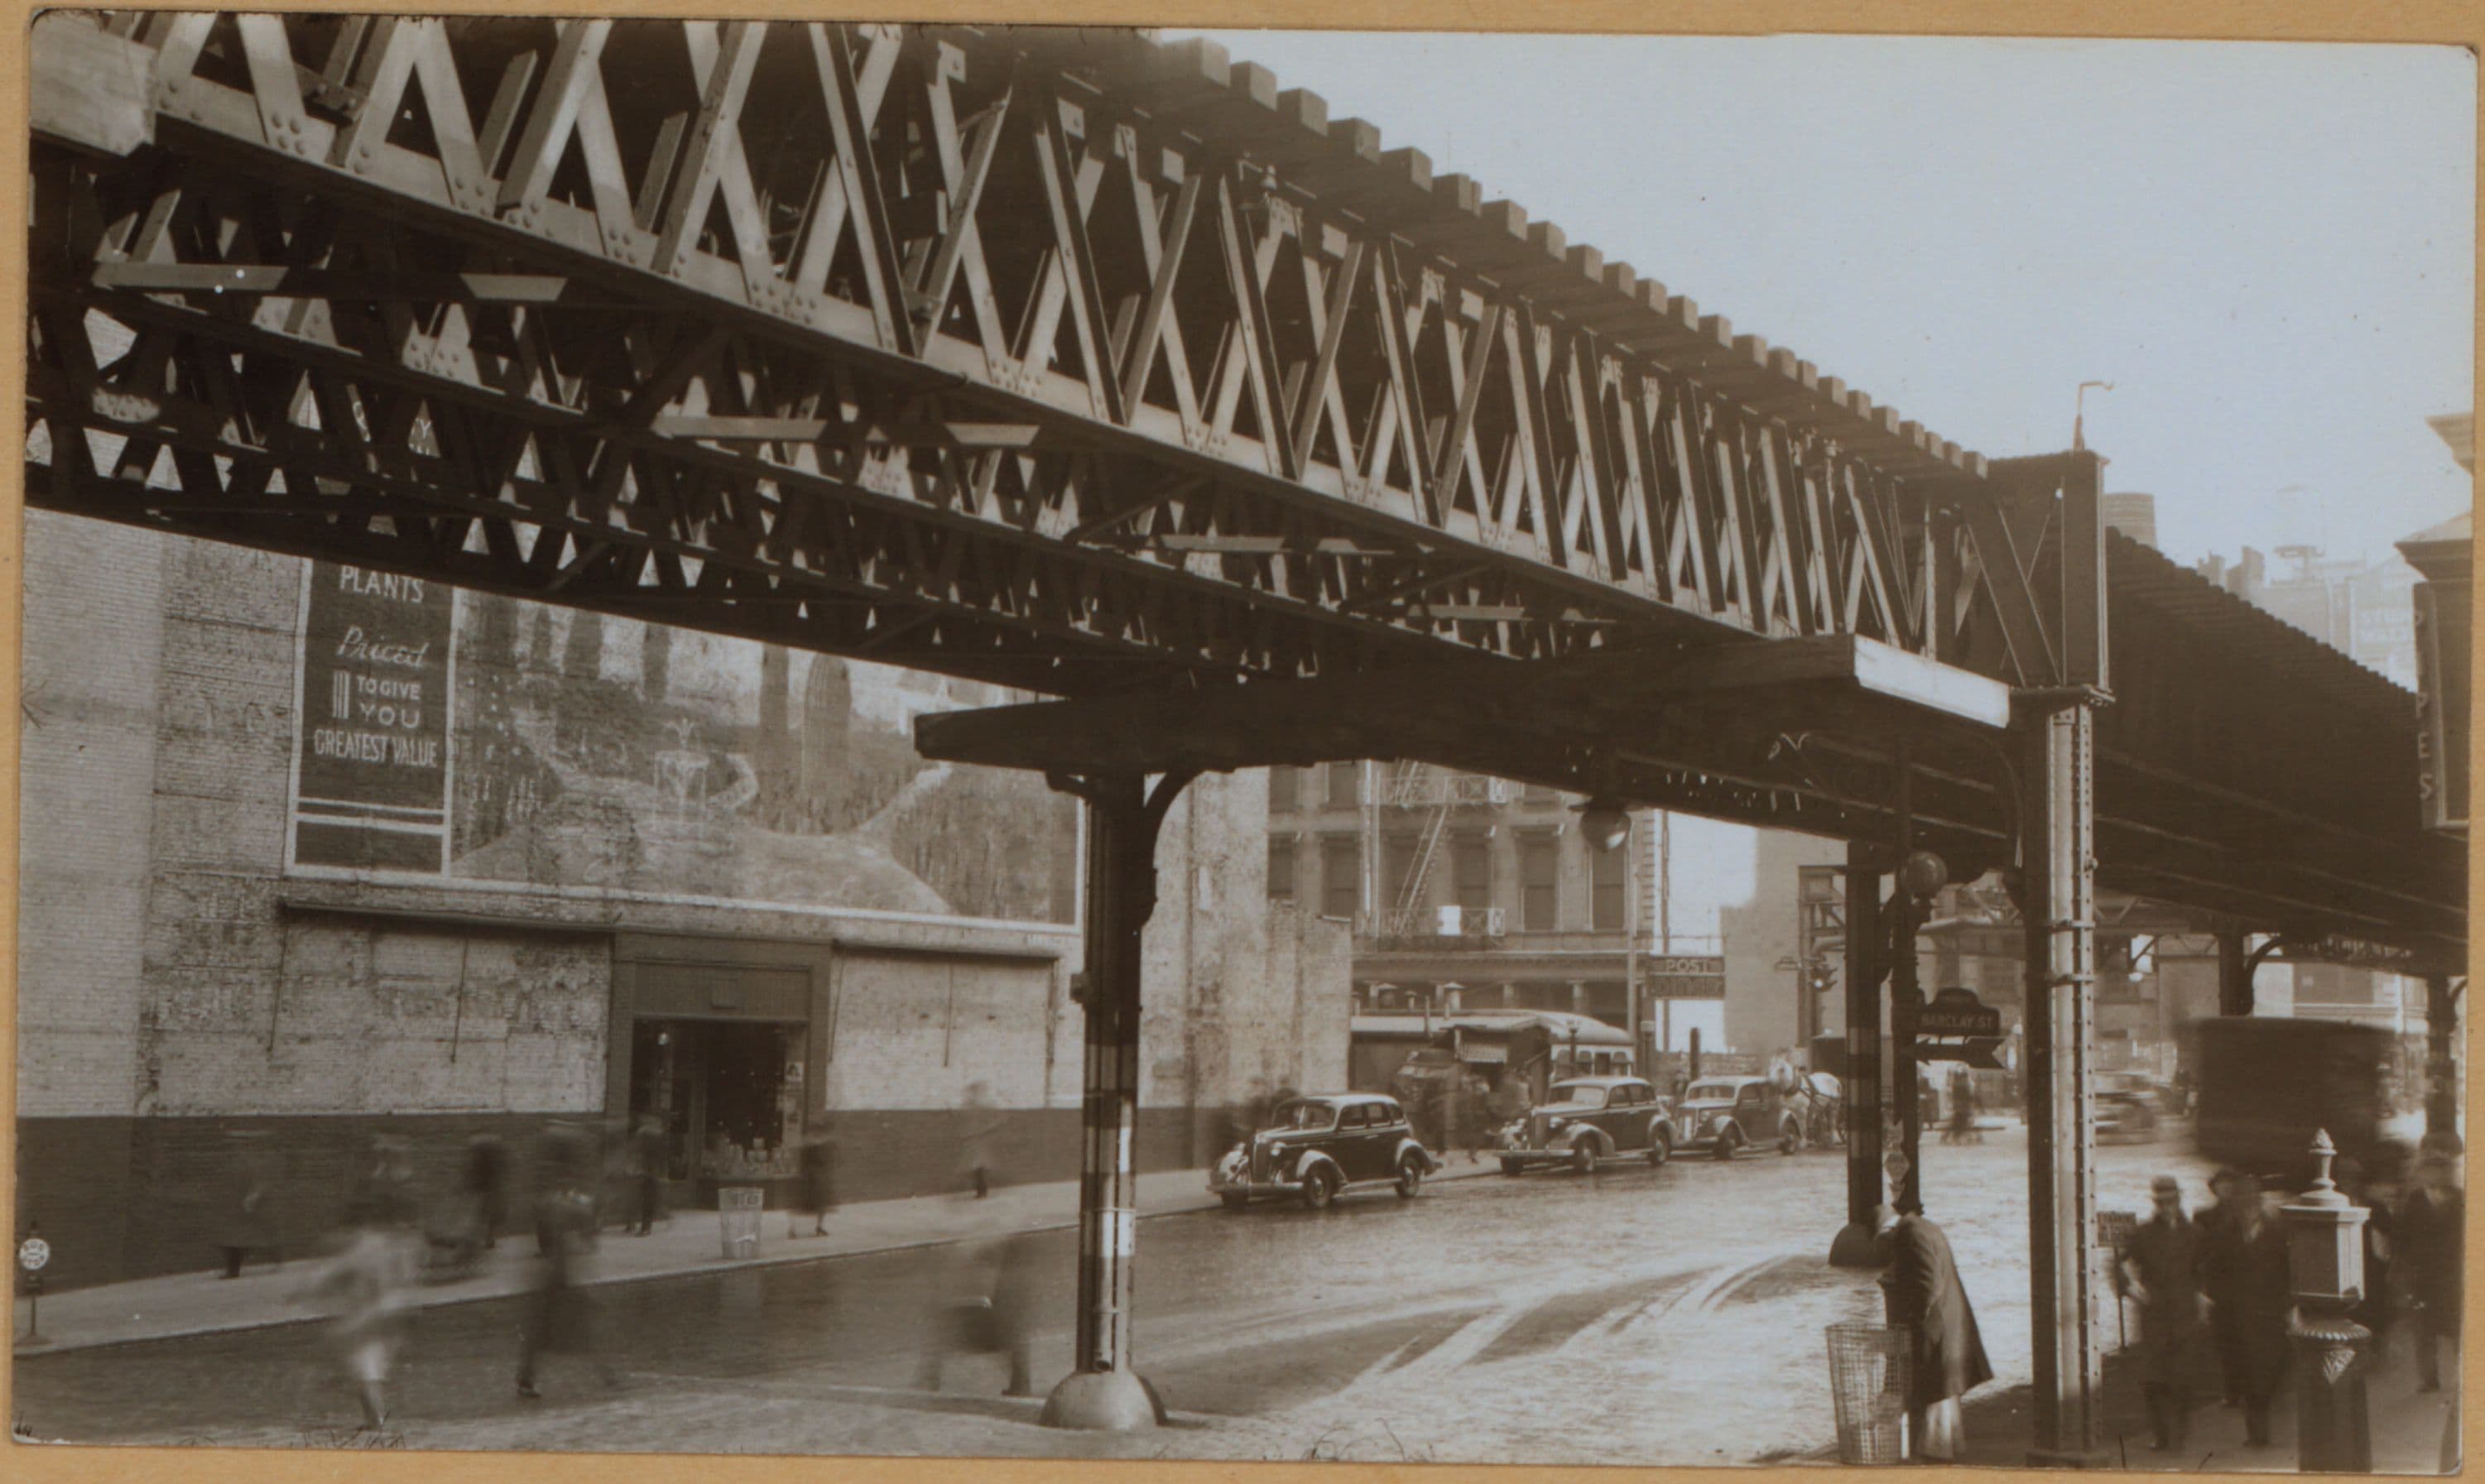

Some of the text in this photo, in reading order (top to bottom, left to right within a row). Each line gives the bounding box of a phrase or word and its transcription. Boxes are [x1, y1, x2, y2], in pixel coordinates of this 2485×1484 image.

[340, 565, 425, 603] PLANTS
[337, 627, 430, 669] Priced
[357, 675, 422, 700] TO GIVE
[361, 703, 421, 729] YOU
[314, 729, 438, 769] GREATEST VALUE
[1665, 958, 1709, 973] POST
[1920, 1012, 1975, 1028] BARCLAY
